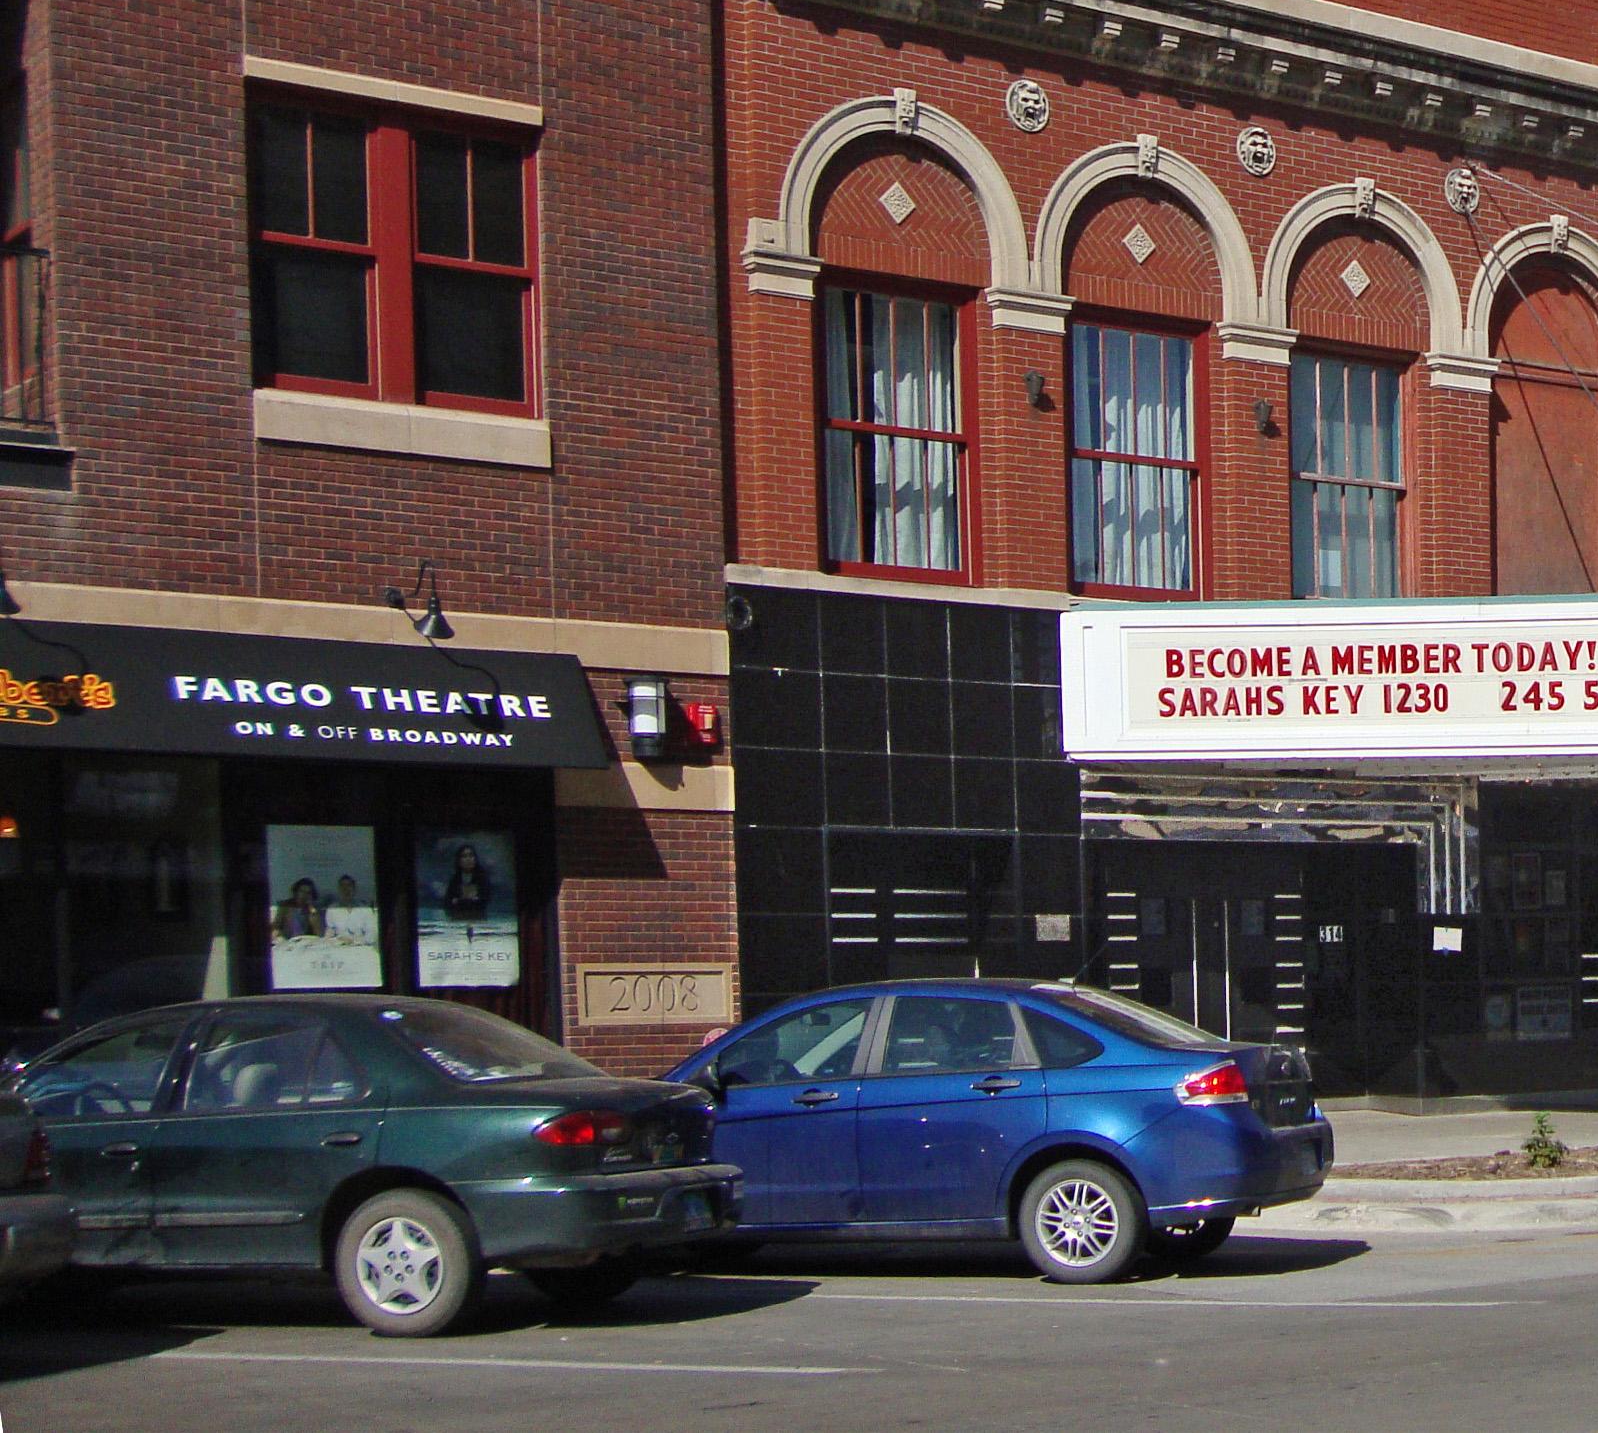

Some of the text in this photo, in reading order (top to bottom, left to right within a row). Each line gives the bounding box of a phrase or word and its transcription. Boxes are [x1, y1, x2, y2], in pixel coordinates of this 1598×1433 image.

[1165, 640, 1597, 679] BECOME A MEMBER TODAY!
[173, 675, 552, 719] FARGO THEATRE
[1158, 686, 1285, 718] SARAHS
[1302, 685, 1363, 716] KEY
[1383, 683, 1449, 714] 1230
[1500, 680, 1565, 712] 245
[235, 721, 514, 747] ON & OFF BROADWAY
[1320, 926, 1343, 942] 314
[487, 951, 512, 962] KEY
[609, 974, 699, 1013] 2008
